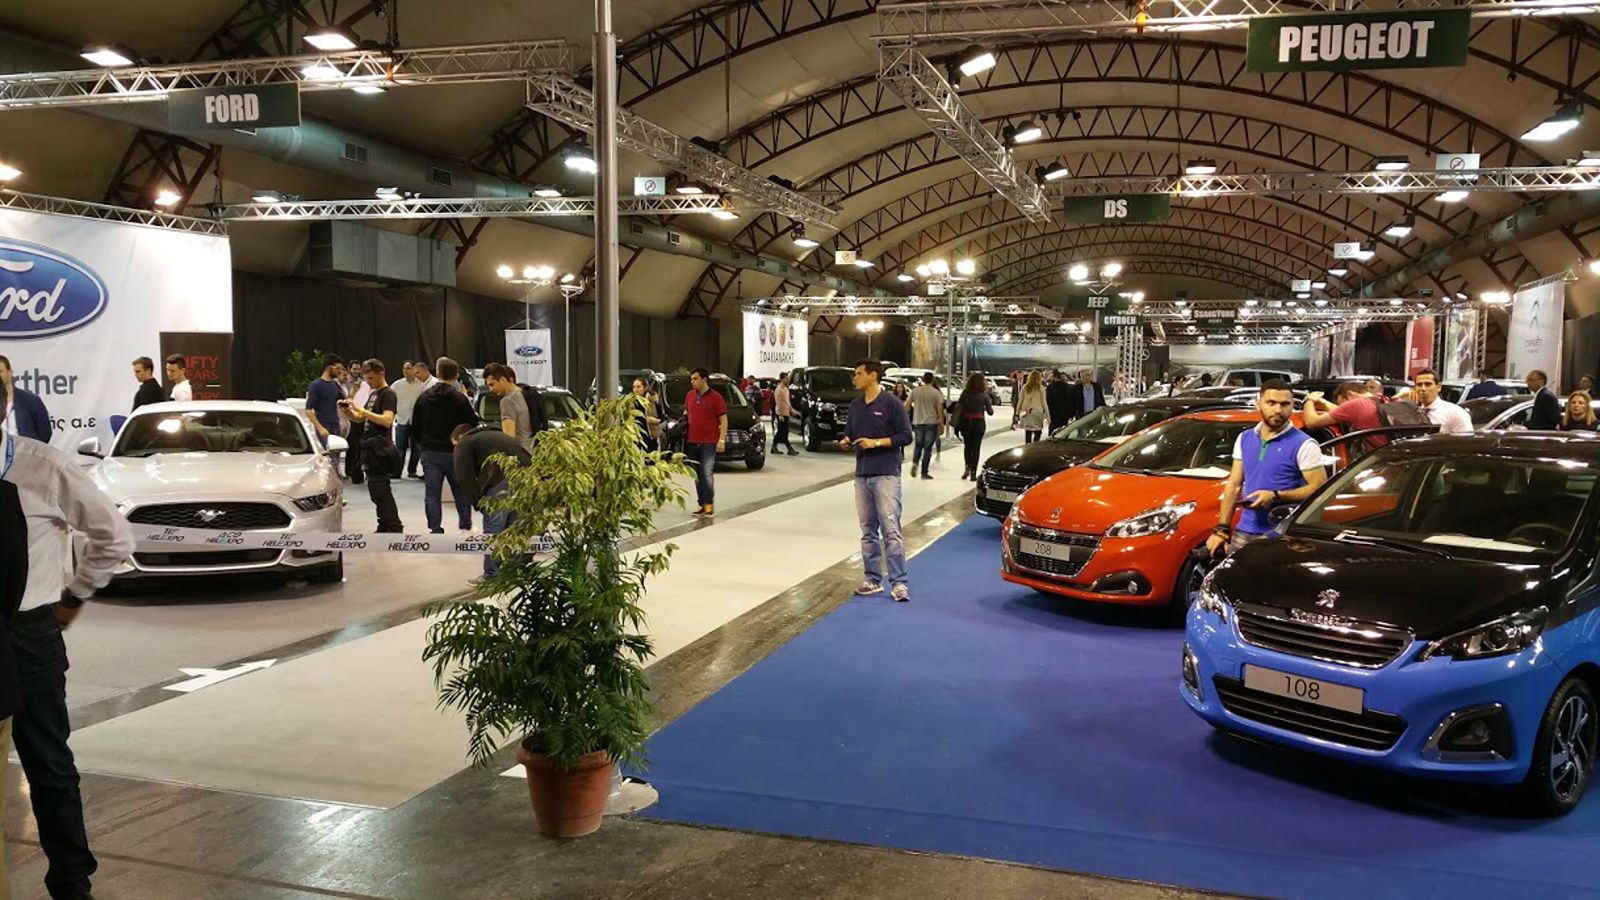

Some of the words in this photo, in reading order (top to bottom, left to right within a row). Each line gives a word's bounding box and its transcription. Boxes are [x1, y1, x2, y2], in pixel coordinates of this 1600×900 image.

[1278, 21, 1436, 63] PEUGEOT
[205, 93, 259, 123] FORD
[1104, 199, 1128, 218] DS
[1087, 296, 1109, 308] JEEP
[1104, 316, 1137, 325] CITROEN
[184, 355, 219, 369] IFTY
[186, 370, 217, 379] EARS
[388, 542, 430, 551] HELEXPO
[1035, 543, 1052, 556] 208
[1285, 676, 1320, 700] 108
